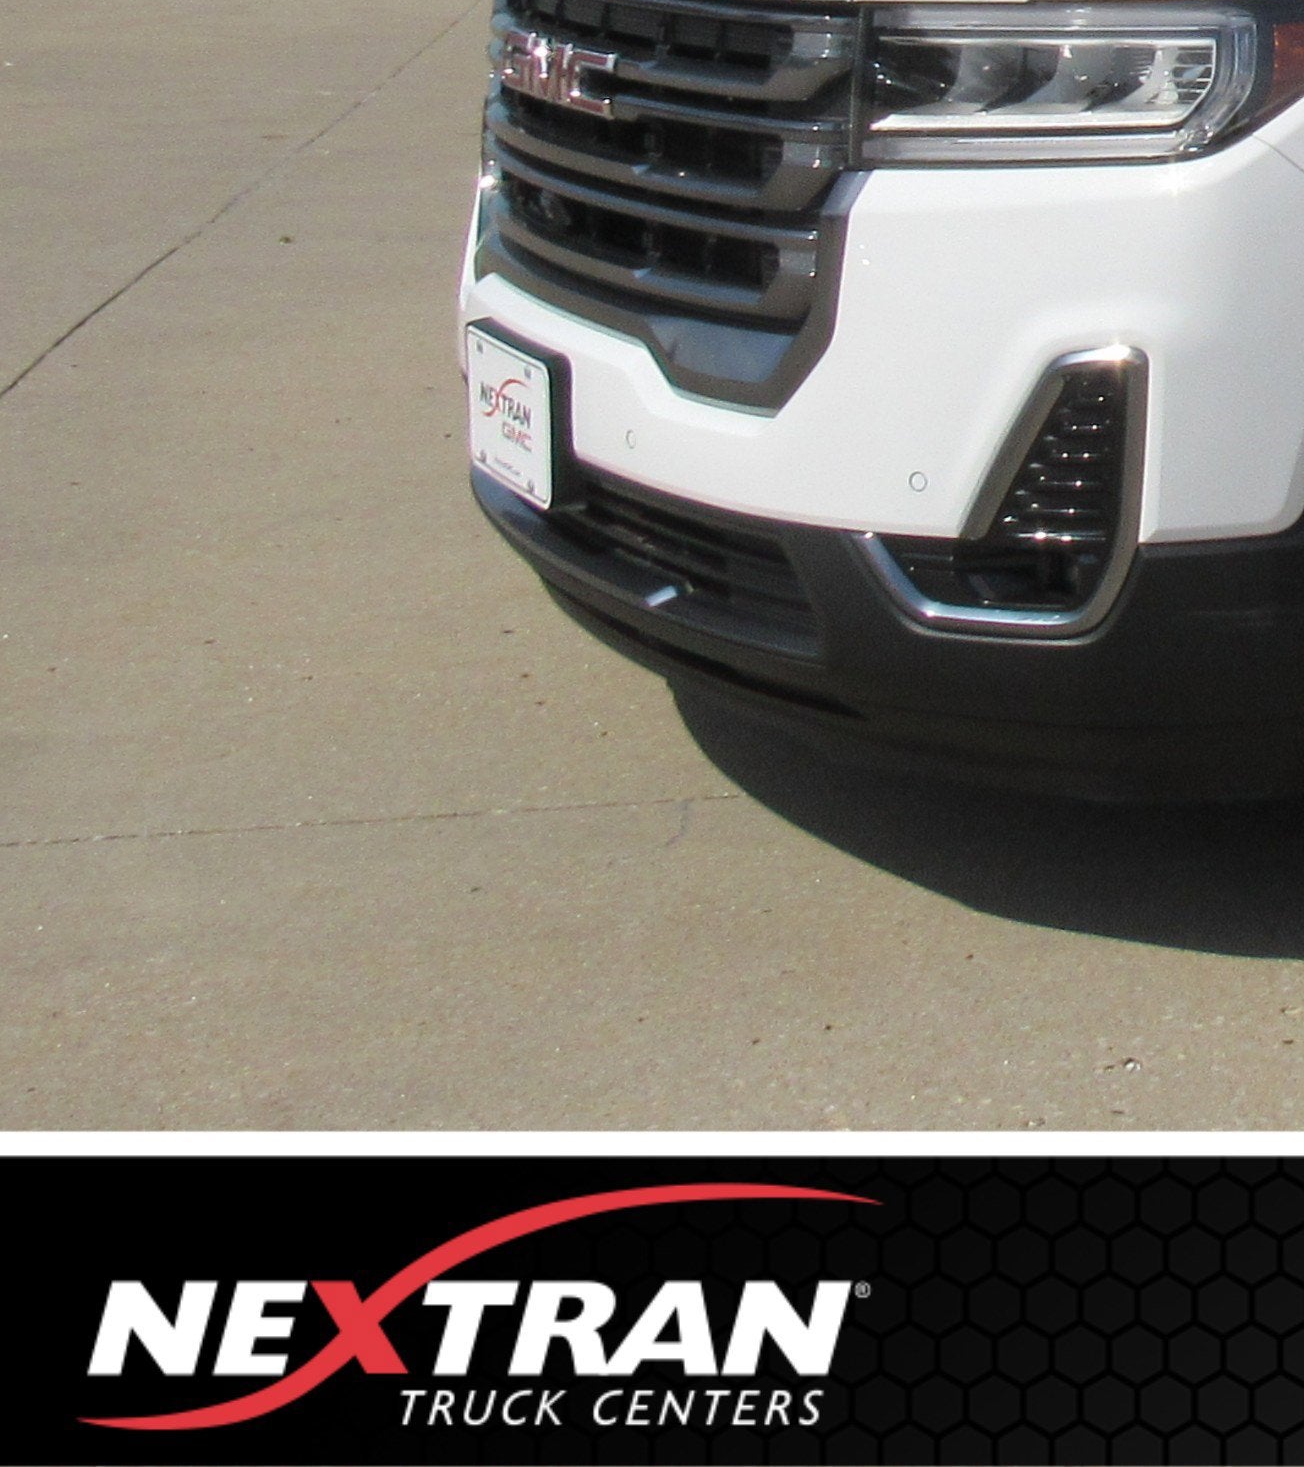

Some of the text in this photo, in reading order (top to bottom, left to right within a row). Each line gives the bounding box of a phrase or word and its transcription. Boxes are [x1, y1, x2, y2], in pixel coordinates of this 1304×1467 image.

[502, 32, 617, 120] GMC
[479, 380, 532, 429] NEXTRAN
[502, 421, 532, 452] GMC
